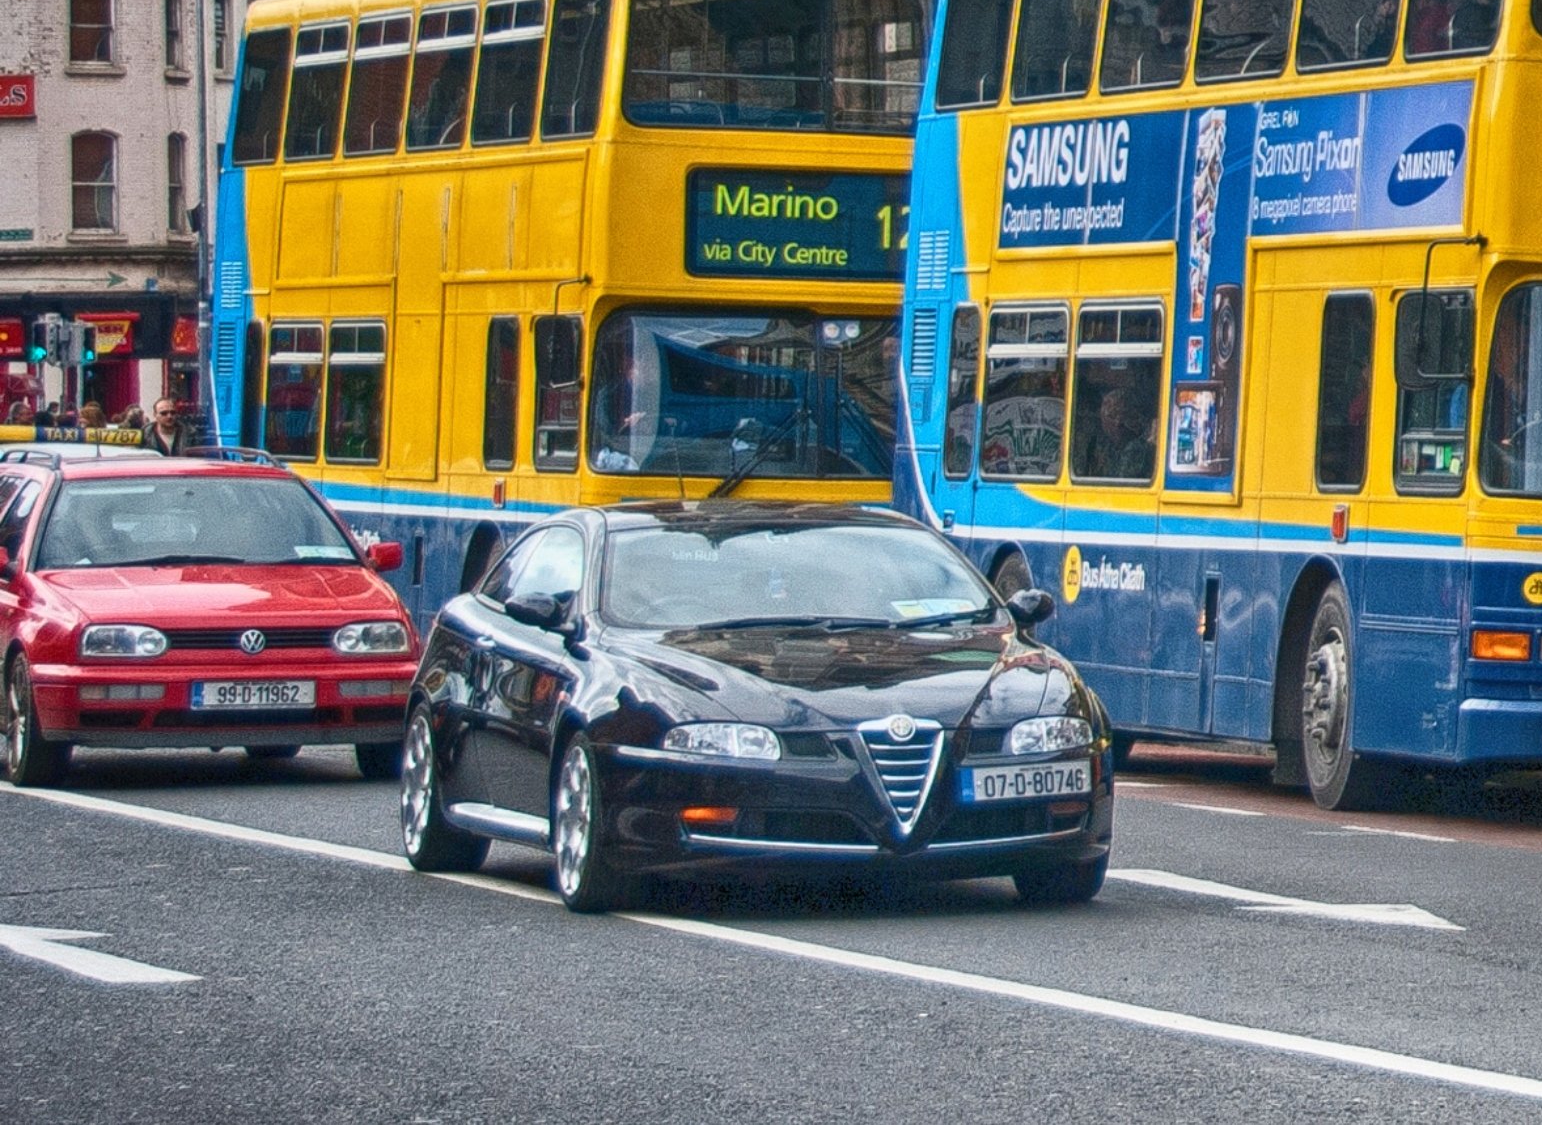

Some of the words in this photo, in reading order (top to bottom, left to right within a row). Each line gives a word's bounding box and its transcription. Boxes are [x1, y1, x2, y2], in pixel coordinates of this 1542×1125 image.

[1007, 120, 1130, 190] SAMSUNG
[1255, 136, 1314, 183] Samsung
[1315, 130, 1361, 172] Pixon
[1397, 148, 1456, 182] SAMSUNG
[715, 184, 838, 220] Marino
[1002, 202, 1042, 240] Capture
[1043, 200, 1061, 230] the
[1061, 196, 1125, 231] unexpected
[1253, 195, 1260, 220] 8
[1260, 192, 1301, 225] megapixel
[1302, 194, 1332, 216] camera
[1332, 188, 1357, 220] phone
[703, 239, 732, 261] via
[738, 240, 776, 267] City
[783, 242, 848, 266] Centre
[44, 427, 79, 441] TAXI
[1082, 561, 1099, 588] Bus
[1099, 555, 1119, 590] Átha
[1120, 562, 1145, 591] Cliath
[984, 769, 1084, 797] 07-D-80746
